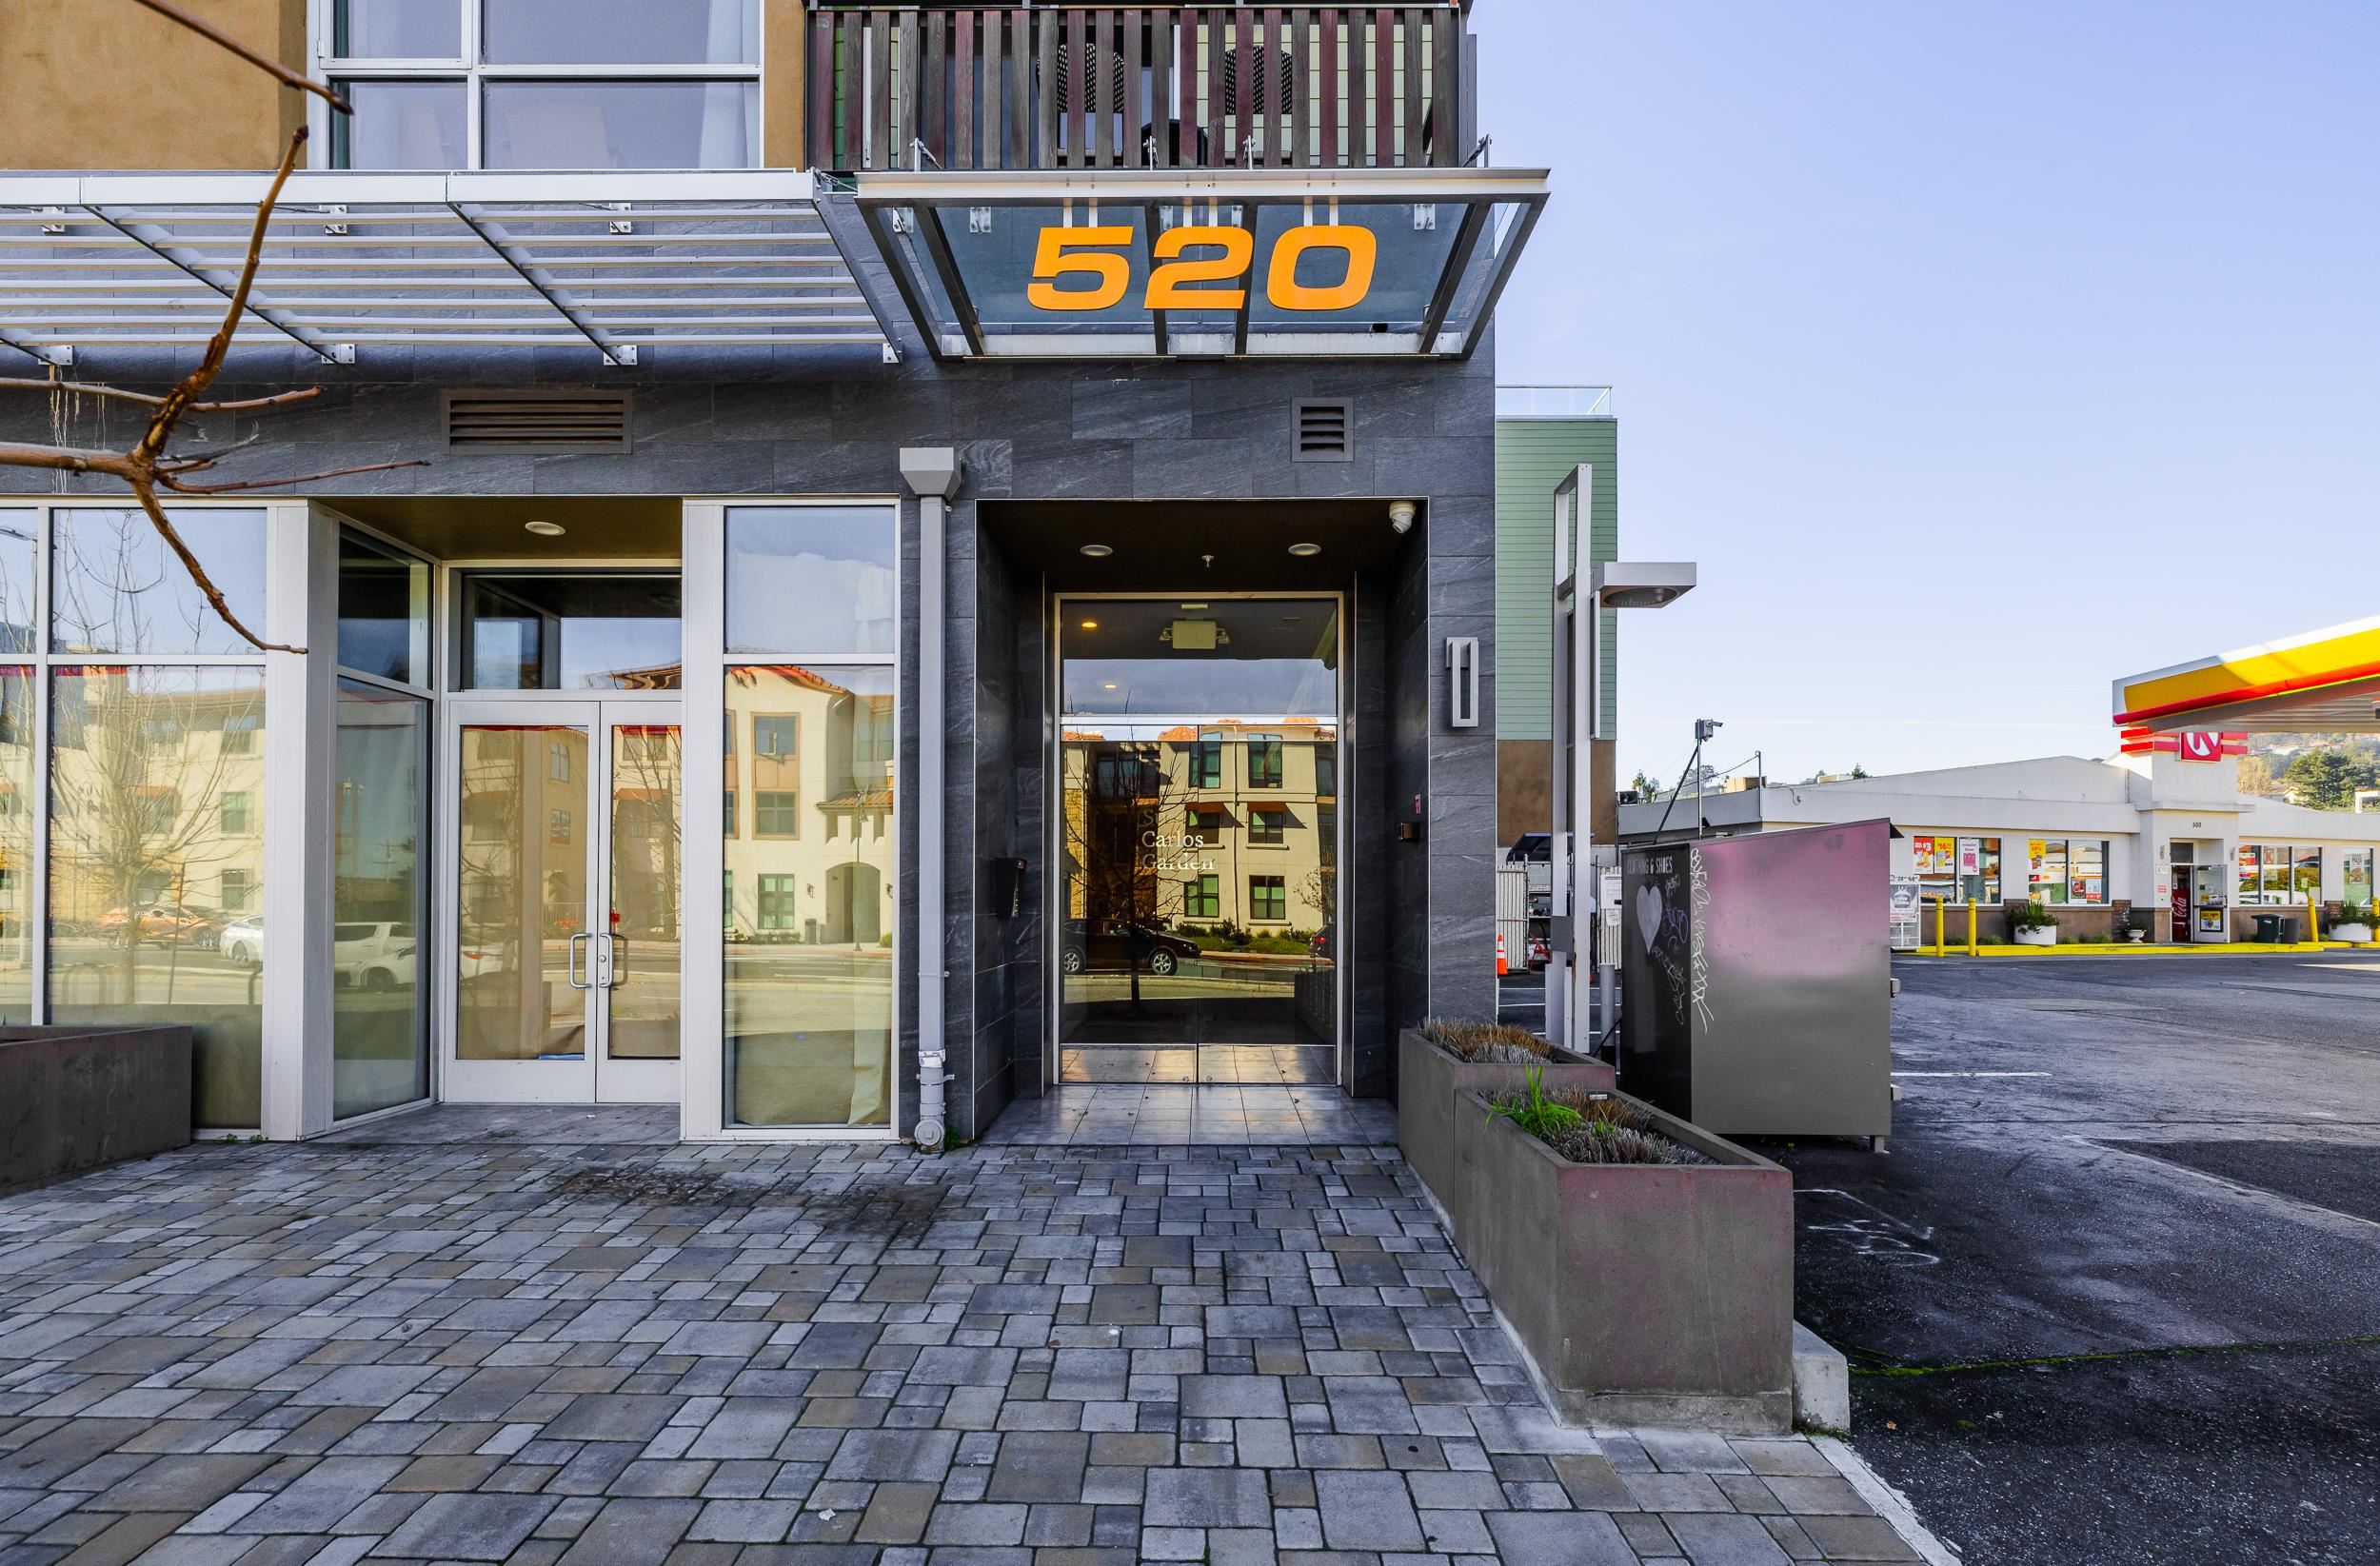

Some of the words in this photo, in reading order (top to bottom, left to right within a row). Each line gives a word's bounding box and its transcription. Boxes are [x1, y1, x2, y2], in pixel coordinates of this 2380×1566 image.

[1027, 225, 1378, 310] 520
[1142, 830, 1204, 848] Carlos
[1142, 853, 1216, 870] Garden
